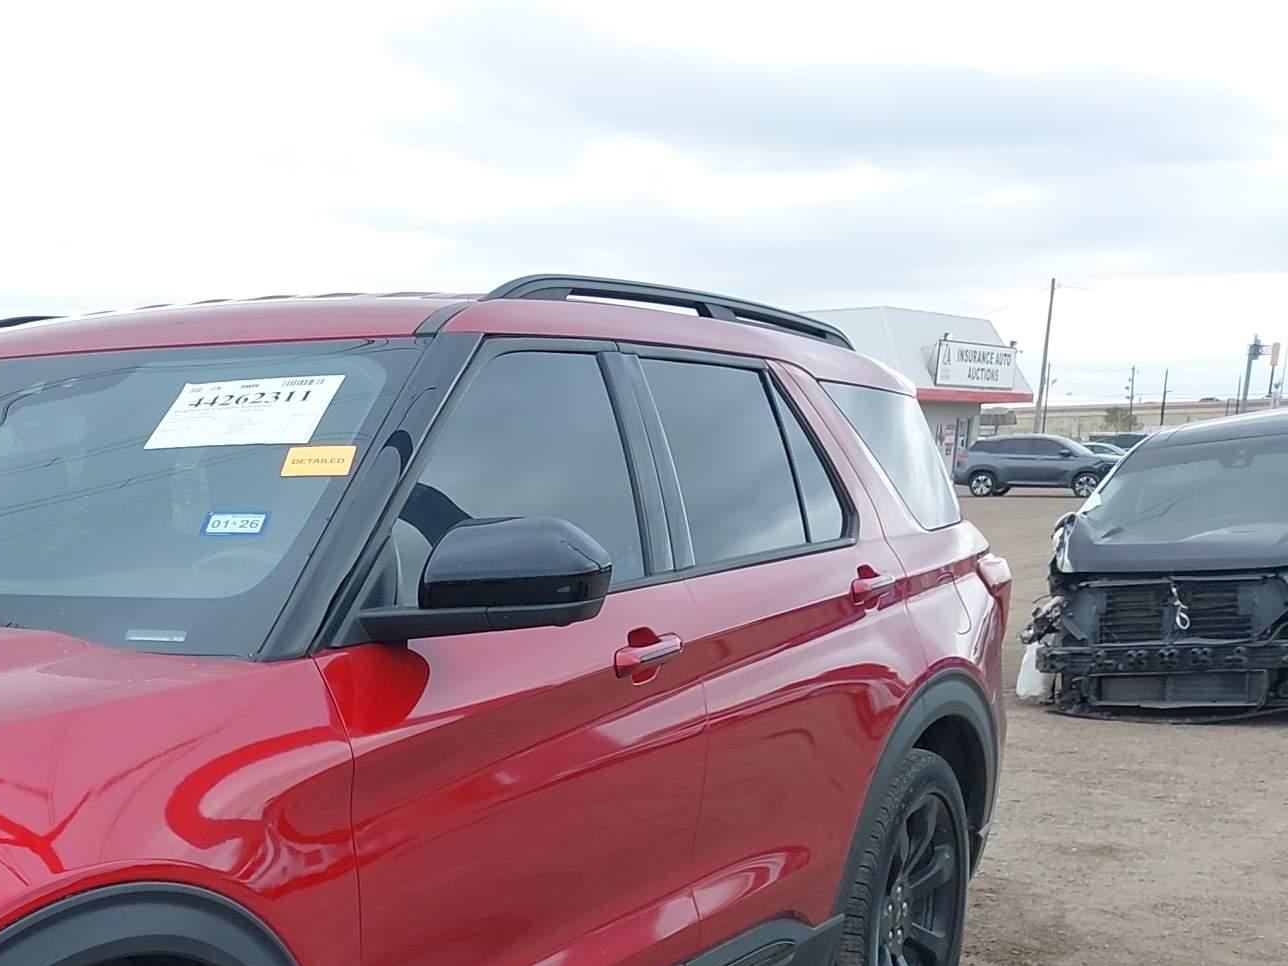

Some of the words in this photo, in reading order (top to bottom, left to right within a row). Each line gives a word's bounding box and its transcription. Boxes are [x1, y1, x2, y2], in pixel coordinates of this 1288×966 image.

[957, 349, 994, 365] INSURANCE
[995, 353, 1012, 366] AUTO
[968, 367, 999, 382] AUCTIONS
[188, 389, 312, 409] 44262311
[291, 457, 345, 465] DETAILED
